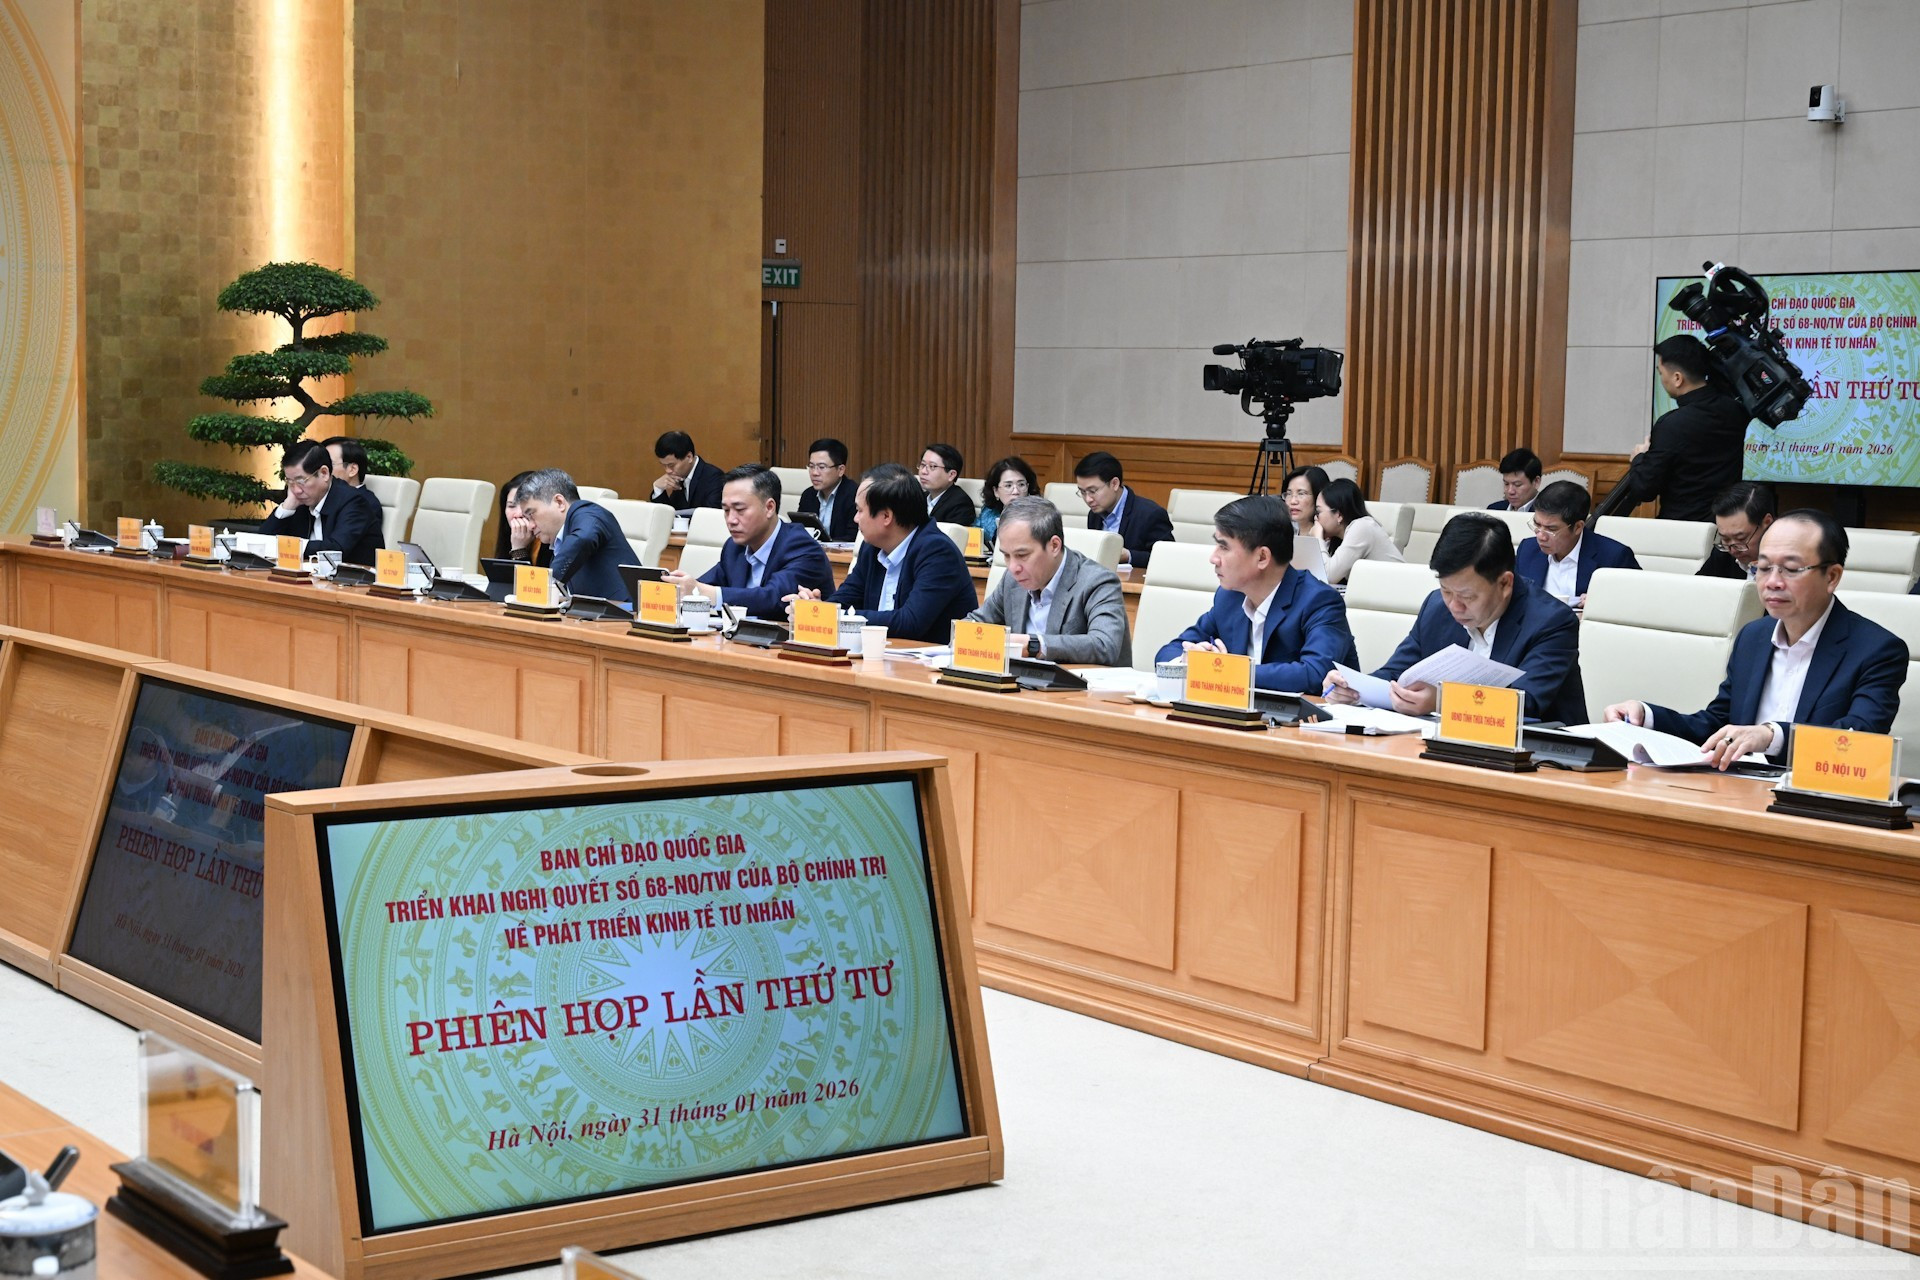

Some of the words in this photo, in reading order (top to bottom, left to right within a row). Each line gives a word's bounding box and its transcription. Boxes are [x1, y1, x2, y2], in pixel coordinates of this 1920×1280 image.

[762, 267, 798, 285] EXIT
[1789, 297, 1808, 312] ĐẠO
[1811, 293, 1837, 311] QUỐC
[1839, 296, 1856, 309] GIA
[1783, 313, 1796, 329] SỐ
[1798, 316, 1845, 331] 68-NQ/TW
[1847, 313, 1867, 329] CỦA
[1870, 314, 1883, 331] BỘ
[1886, 313, 1917, 329] CHÍNH
[1795, 337, 1818, 349] KINH
[1821, 333, 1832, 350] TẾ
[1834, 336, 1847, 349] TƯ
[1849, 334, 1876, 350] NHÂN
[1809, 370, 1841, 400] ẦN
[1846, 375, 1894, 400] THỨ
[1773, 441, 1785, 453] 31
[1788, 441, 1819, 456] tháng
[1822, 442, 1835, 454] 01
[1838, 443, 1863, 454] năm
[1866, 443, 1894, 455] 2026
[1552, 744, 1577, 754] BOSCH
[1815, 760, 1829, 775] BỘ
[1832, 763, 1850, 778] NỘI
[1853, 767, 1867, 780] VỤ
[116, 825, 164, 862] PHIÊN
[162, 840, 196, 877] HỌP
[195, 842, 230, 887] LẦN
[540, 848, 581, 872] BAN
[585, 837, 617, 868] CHỈ
[621, 841, 658, 868] ĐẠO
[663, 829, 711, 861] QUỐC
[716, 834, 746, 855] GIA
[385, 889, 444, 924] TRIỂN
[449, 892, 496, 917] KHAI
[501, 888, 548, 914] NGHỊ
[553, 876, 610, 909] QUYẾT
[615, 871, 640, 901] SỐ
[645, 869, 731, 899] 68-NQ/TW
[737, 861, 773, 889] CỦA
[776, 859, 800, 888] BỘ
[804, 856, 857, 883] CHÍNH
[860, 855, 887, 880] TRỊ
[504, 920, 529, 949] VỀ
[534, 918, 582, 946] PHÁT
[587, 907, 642, 941] TRIỂN
[646, 908, 690, 935] KINH
[693, 901, 716, 929] TẾ
[719, 902, 743, 927] TƯ
[746, 896, 796, 924] NHÂN
[406, 999, 549, 1056] PHIÊN
[561, 995, 650, 1041] HỌP
[661, 968, 745, 1024] LẦN
[756, 961, 837, 1012] THỨ
[844, 959, 894, 1001] TƯ
[487, 1126, 521, 1151] Hà
[528, 1120, 574, 1148] Nội,
[581, 1113, 632, 1141] ngày
[638, 1105, 662, 1129] 31
[669, 1100, 728, 1125] tháng
[735, 1092, 757, 1114] 01
[764, 1088, 808, 1110] năm
[814, 1077, 859, 1102] 2026
